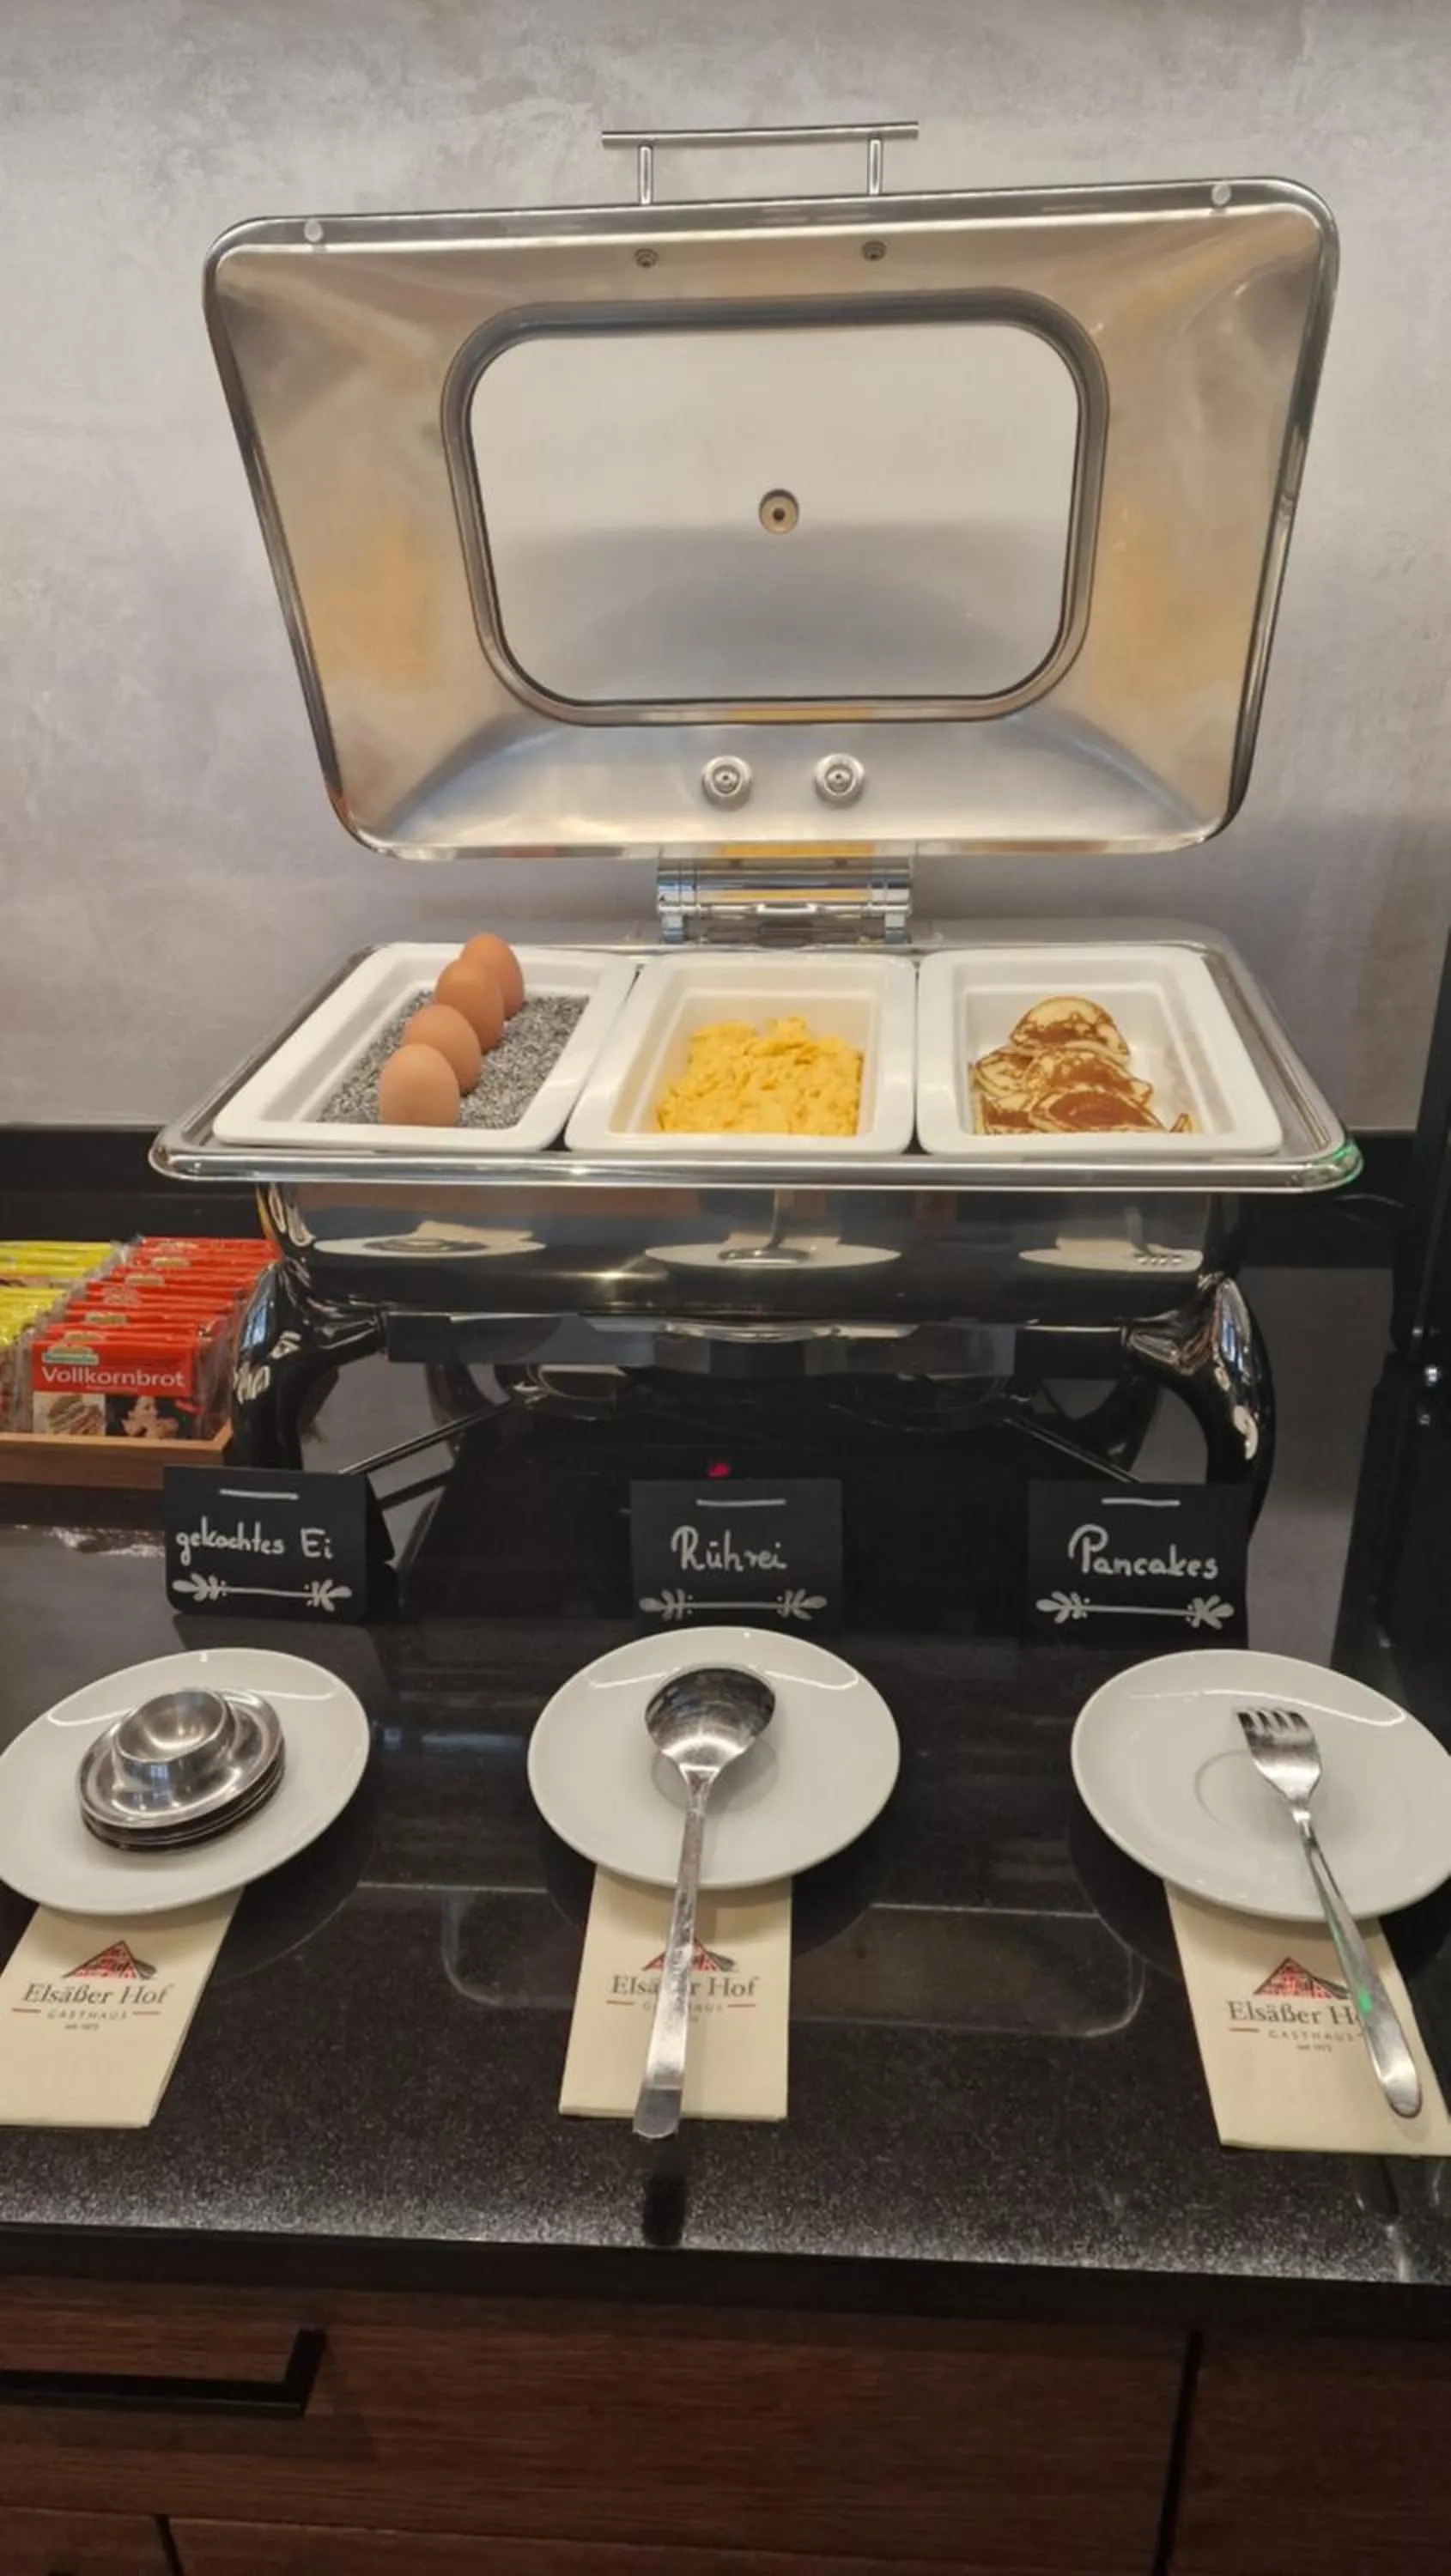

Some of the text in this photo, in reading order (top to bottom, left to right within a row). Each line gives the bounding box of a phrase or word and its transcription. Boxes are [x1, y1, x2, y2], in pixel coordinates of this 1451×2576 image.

[41, 1365, 185, 1388] Vollkornbrot
[175, 1516, 333, 1566] gekochtes Ei
[671, 1524, 787, 1571] Rührei
[1067, 1523, 1219, 1580] Pancakes
[21, 1983, 175, 2005] Elsäßer Hof
[707, 1977, 761, 1997] Hof
[1228, 2000, 1322, 2026] Elsäßer
